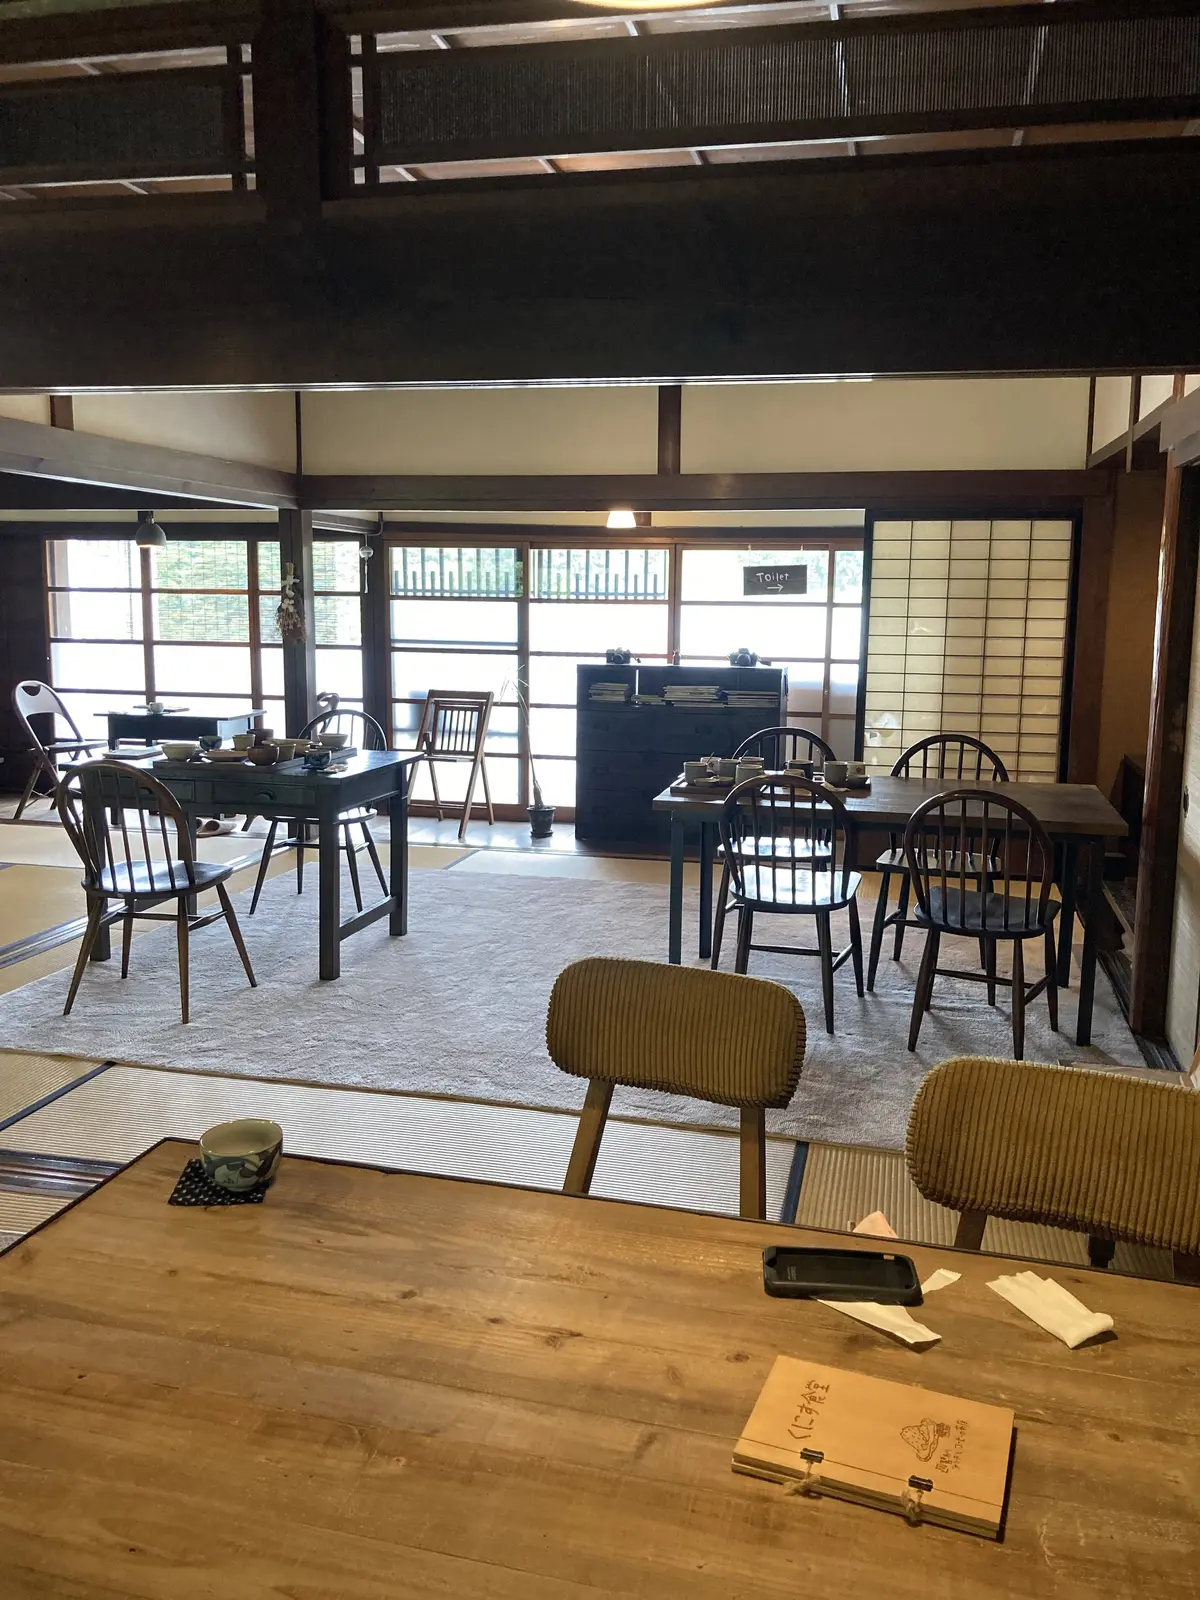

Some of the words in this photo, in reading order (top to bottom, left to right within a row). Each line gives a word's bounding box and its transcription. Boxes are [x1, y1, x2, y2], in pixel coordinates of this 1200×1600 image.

[756, 572, 790, 583] Toilet
[788, 1380, 830, 1439] くにす食堂
